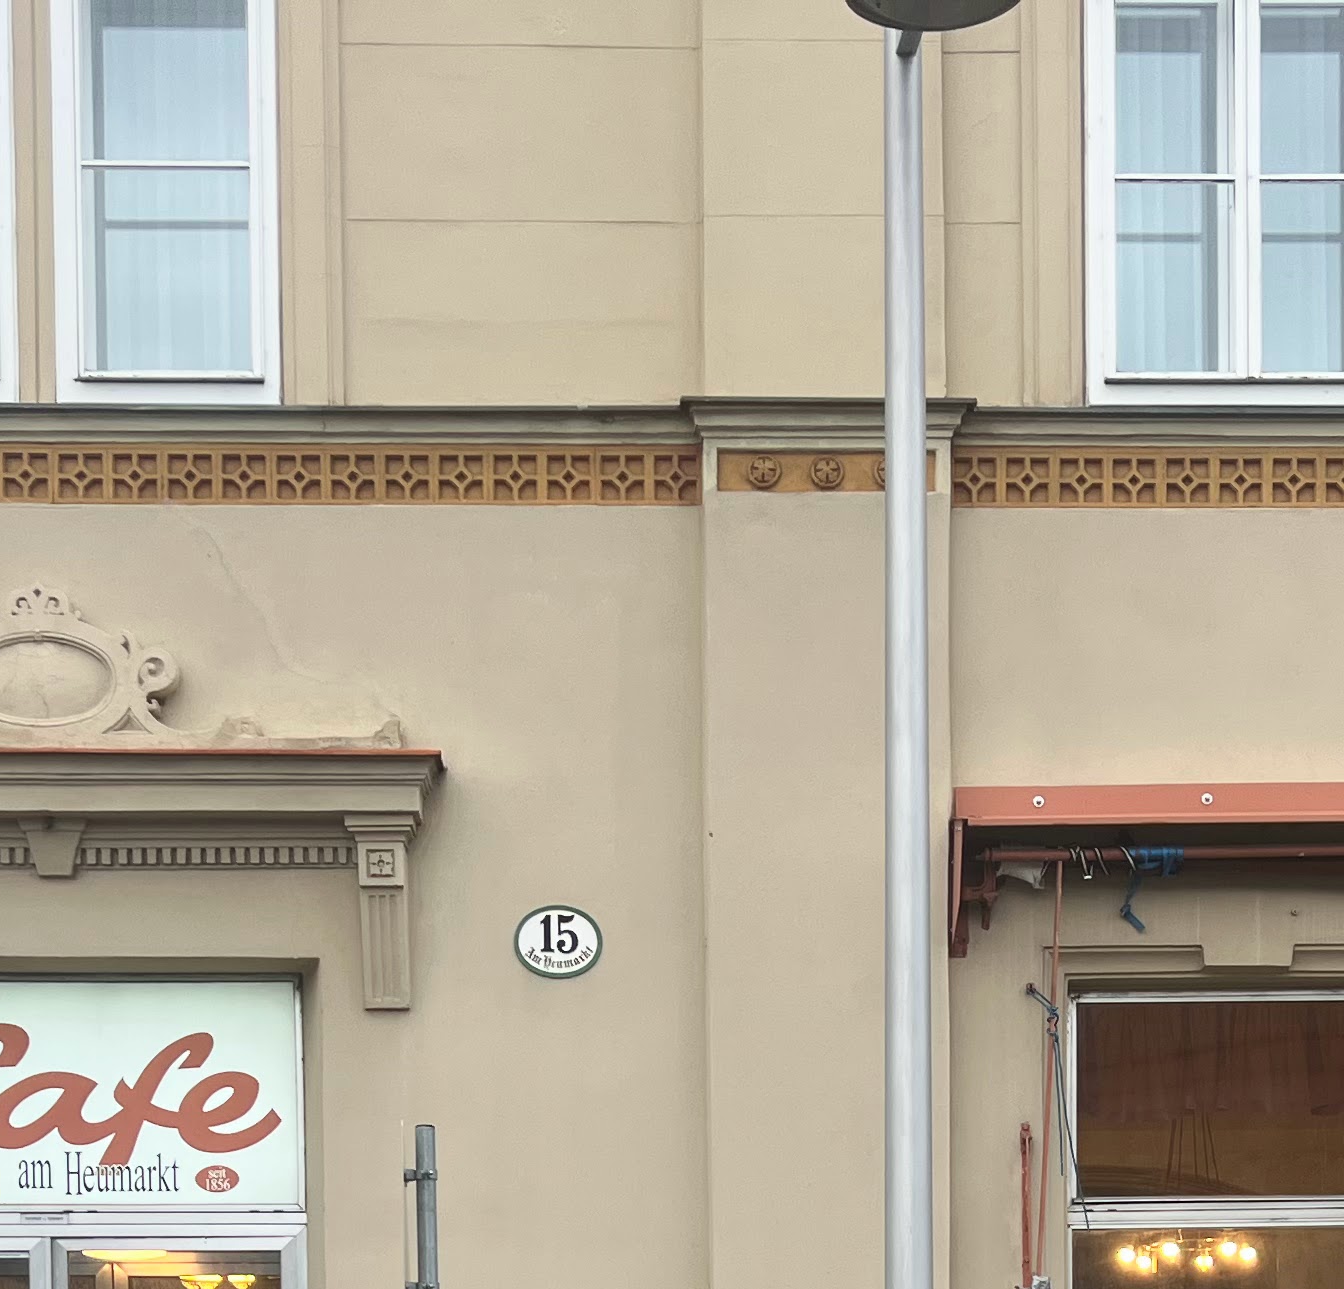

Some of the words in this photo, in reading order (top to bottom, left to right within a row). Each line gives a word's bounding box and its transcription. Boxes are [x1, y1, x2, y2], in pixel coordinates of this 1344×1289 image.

[540, 914, 578, 954] 15
[525, 947, 542, 965] Am
[18, 1159, 53, 1189] am
[65, 1151, 180, 1195] Heumarkt
[207, 1166, 226, 1178] seit
[206, 1178, 231, 1191] 1856
